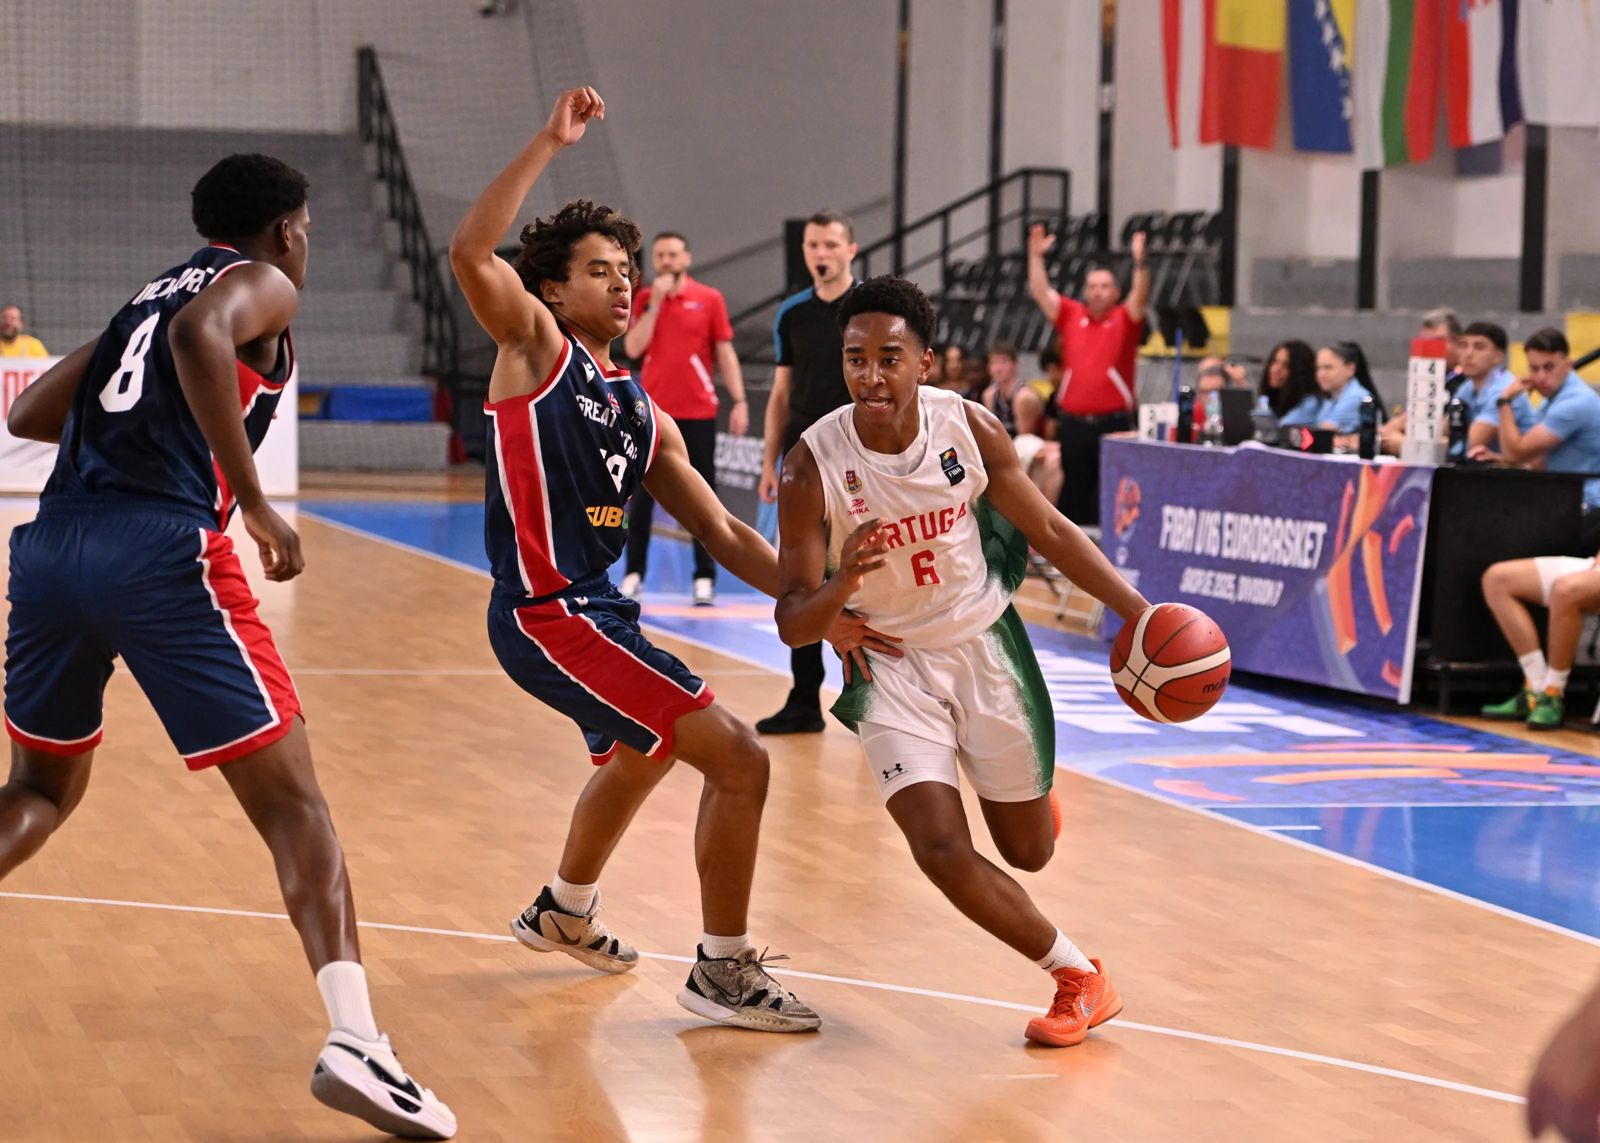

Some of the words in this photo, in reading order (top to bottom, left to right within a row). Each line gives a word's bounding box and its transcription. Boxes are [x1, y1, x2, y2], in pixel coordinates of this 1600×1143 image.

[99, 312, 160, 413] 8
[575, 394, 617, 428] GREAT
[1159, 504, 1197, 553] FIBA
[1220, 511, 1328, 571] EUROBASKET
[911, 550, 940, 587] 6
